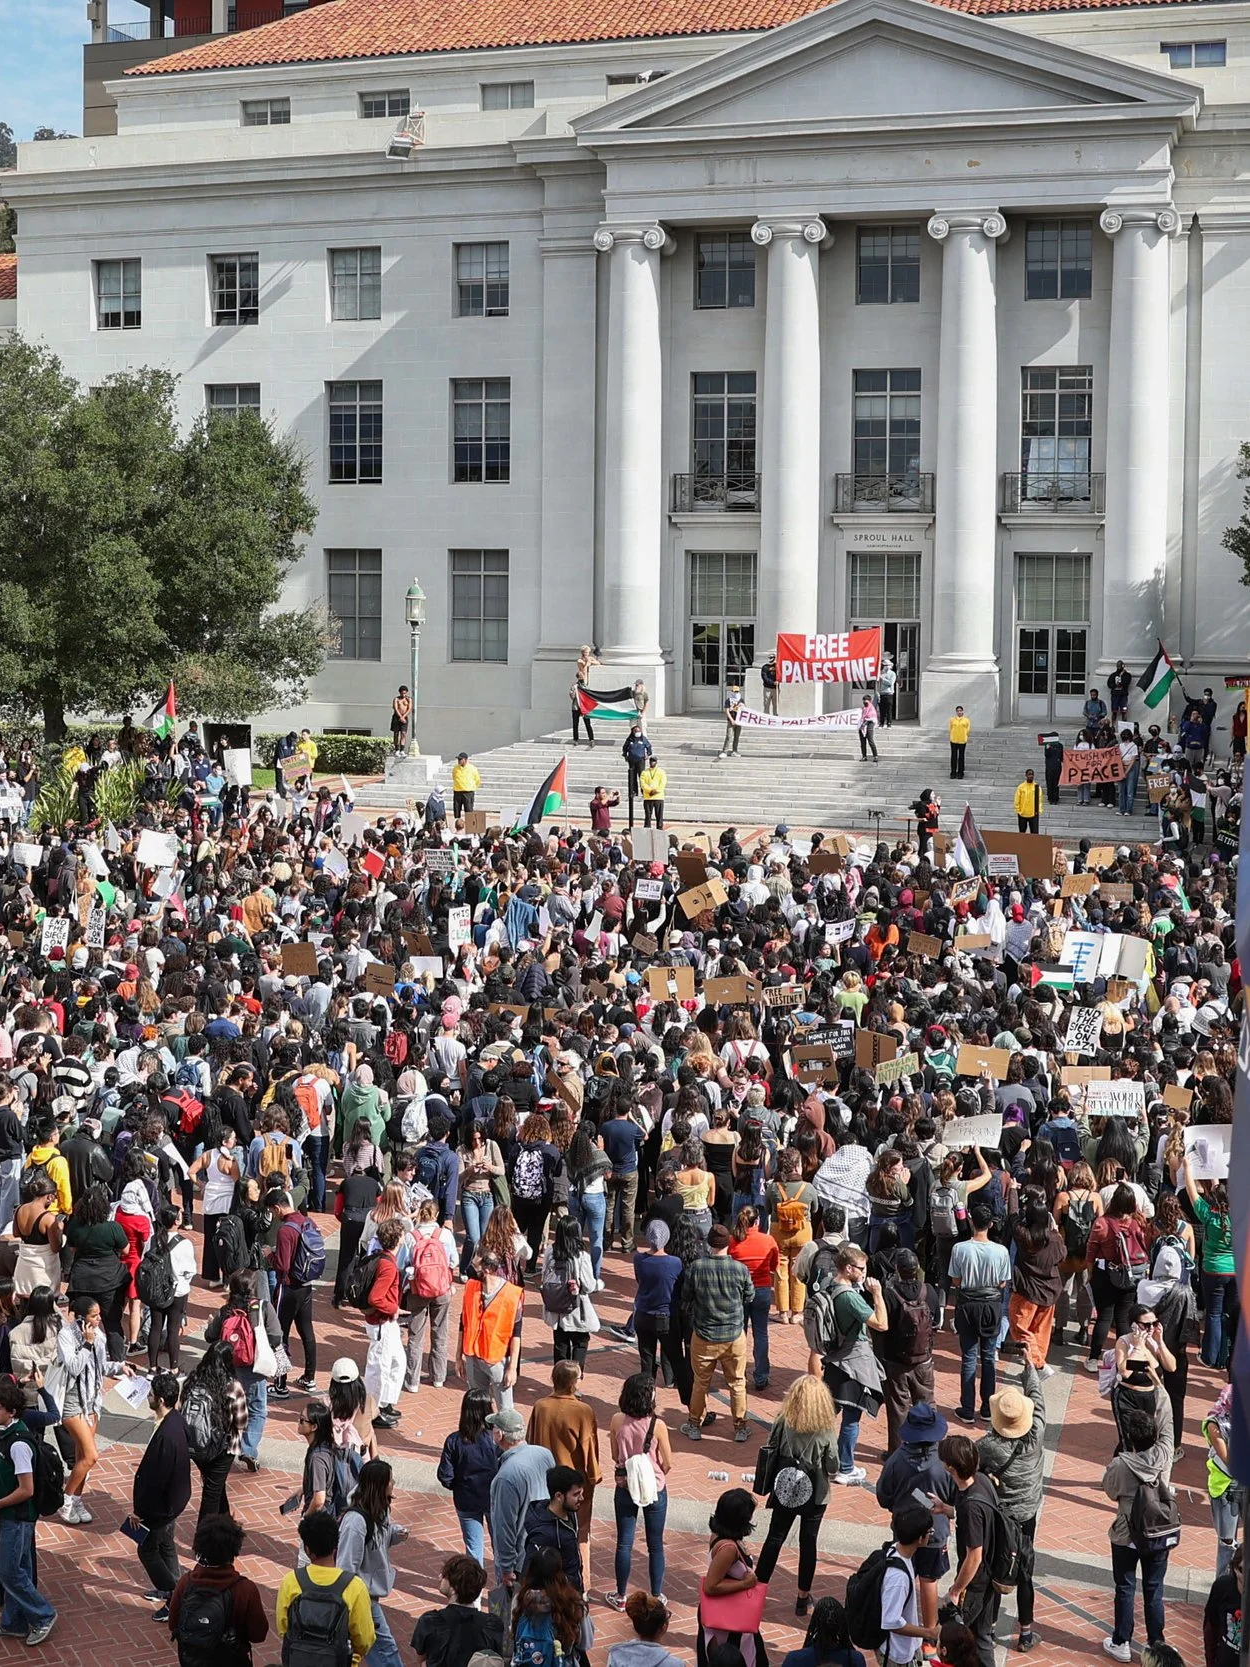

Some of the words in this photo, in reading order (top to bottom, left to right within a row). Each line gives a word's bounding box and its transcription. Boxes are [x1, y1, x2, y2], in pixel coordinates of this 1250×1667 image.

[853, 534, 887, 542] SPROUL
[891, 534, 915, 542] HALL
[805, 632, 849, 659] FREE
[781, 656, 877, 684] PALESTINE
[739, 710, 777, 726] FREE
[1069, 751, 1100, 762] JEWISH
[1068, 763, 1120, 783] PEACE
[1147, 777, 1170, 790] FREE
[452, 909, 470, 920] THIS
[44, 931, 67, 940] SIEGE
[765, 987, 782, 997] FREE
[1078, 1007, 1102, 1018] END
[1076, 1016, 1097, 1026] THE
[1069, 1021, 1097, 1036] SIEGE
[808, 1032, 827, 1041] MONEY
[829, 1030, 839, 1038] FOR
[1075, 1032, 1091, 1041] ON
[1067, 1040, 1096, 1053] GAZA
[1110, 1091, 1143, 1101] WORLD
[1087, 1100, 1143, 1110] REVOLUTION
